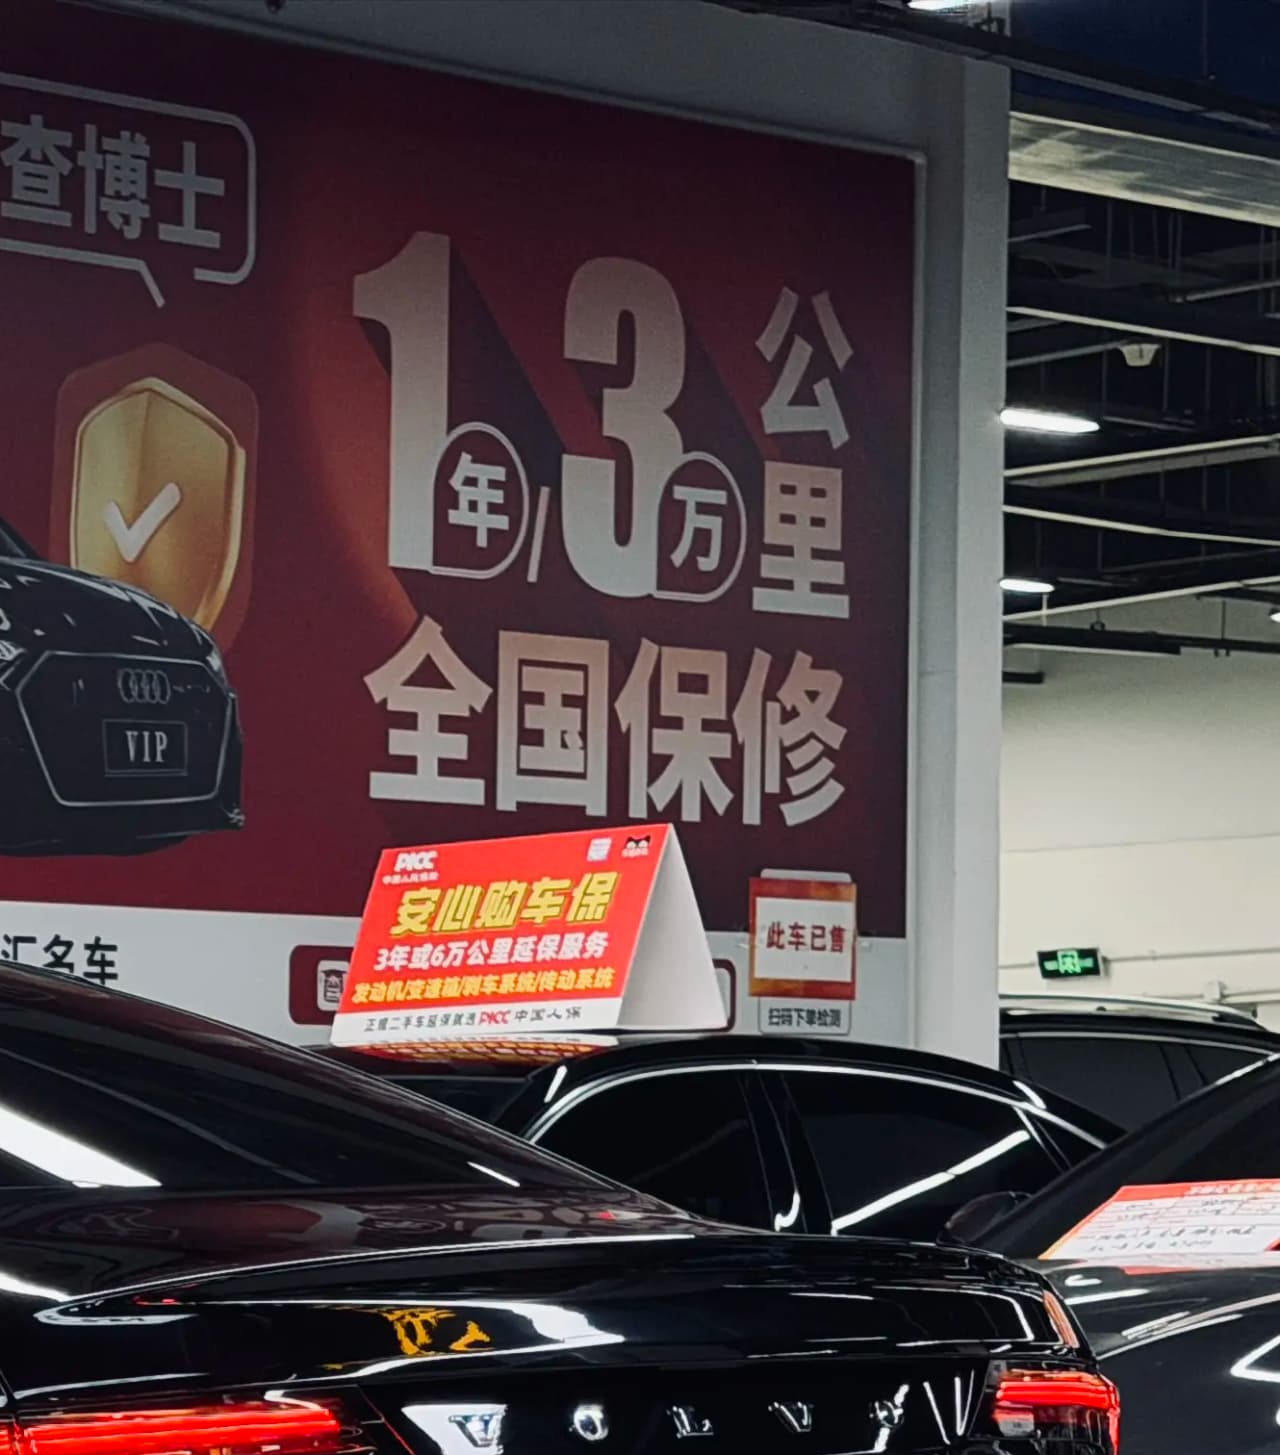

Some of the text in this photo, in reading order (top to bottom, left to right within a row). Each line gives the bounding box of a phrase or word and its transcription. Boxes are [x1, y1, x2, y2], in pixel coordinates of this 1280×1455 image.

[362, 614, 848, 827] 全国保修
[124, 728, 170, 764] VIP
[390, 871, 618, 936] 安心购车保
[373, 931, 609, 971] 3年或6万公里延保服务
[766, 920, 847, 954] 此车已售
[768, 1007, 841, 1028] 扫码下单检测
[448, 1399, 905, 1448] VOLVO
